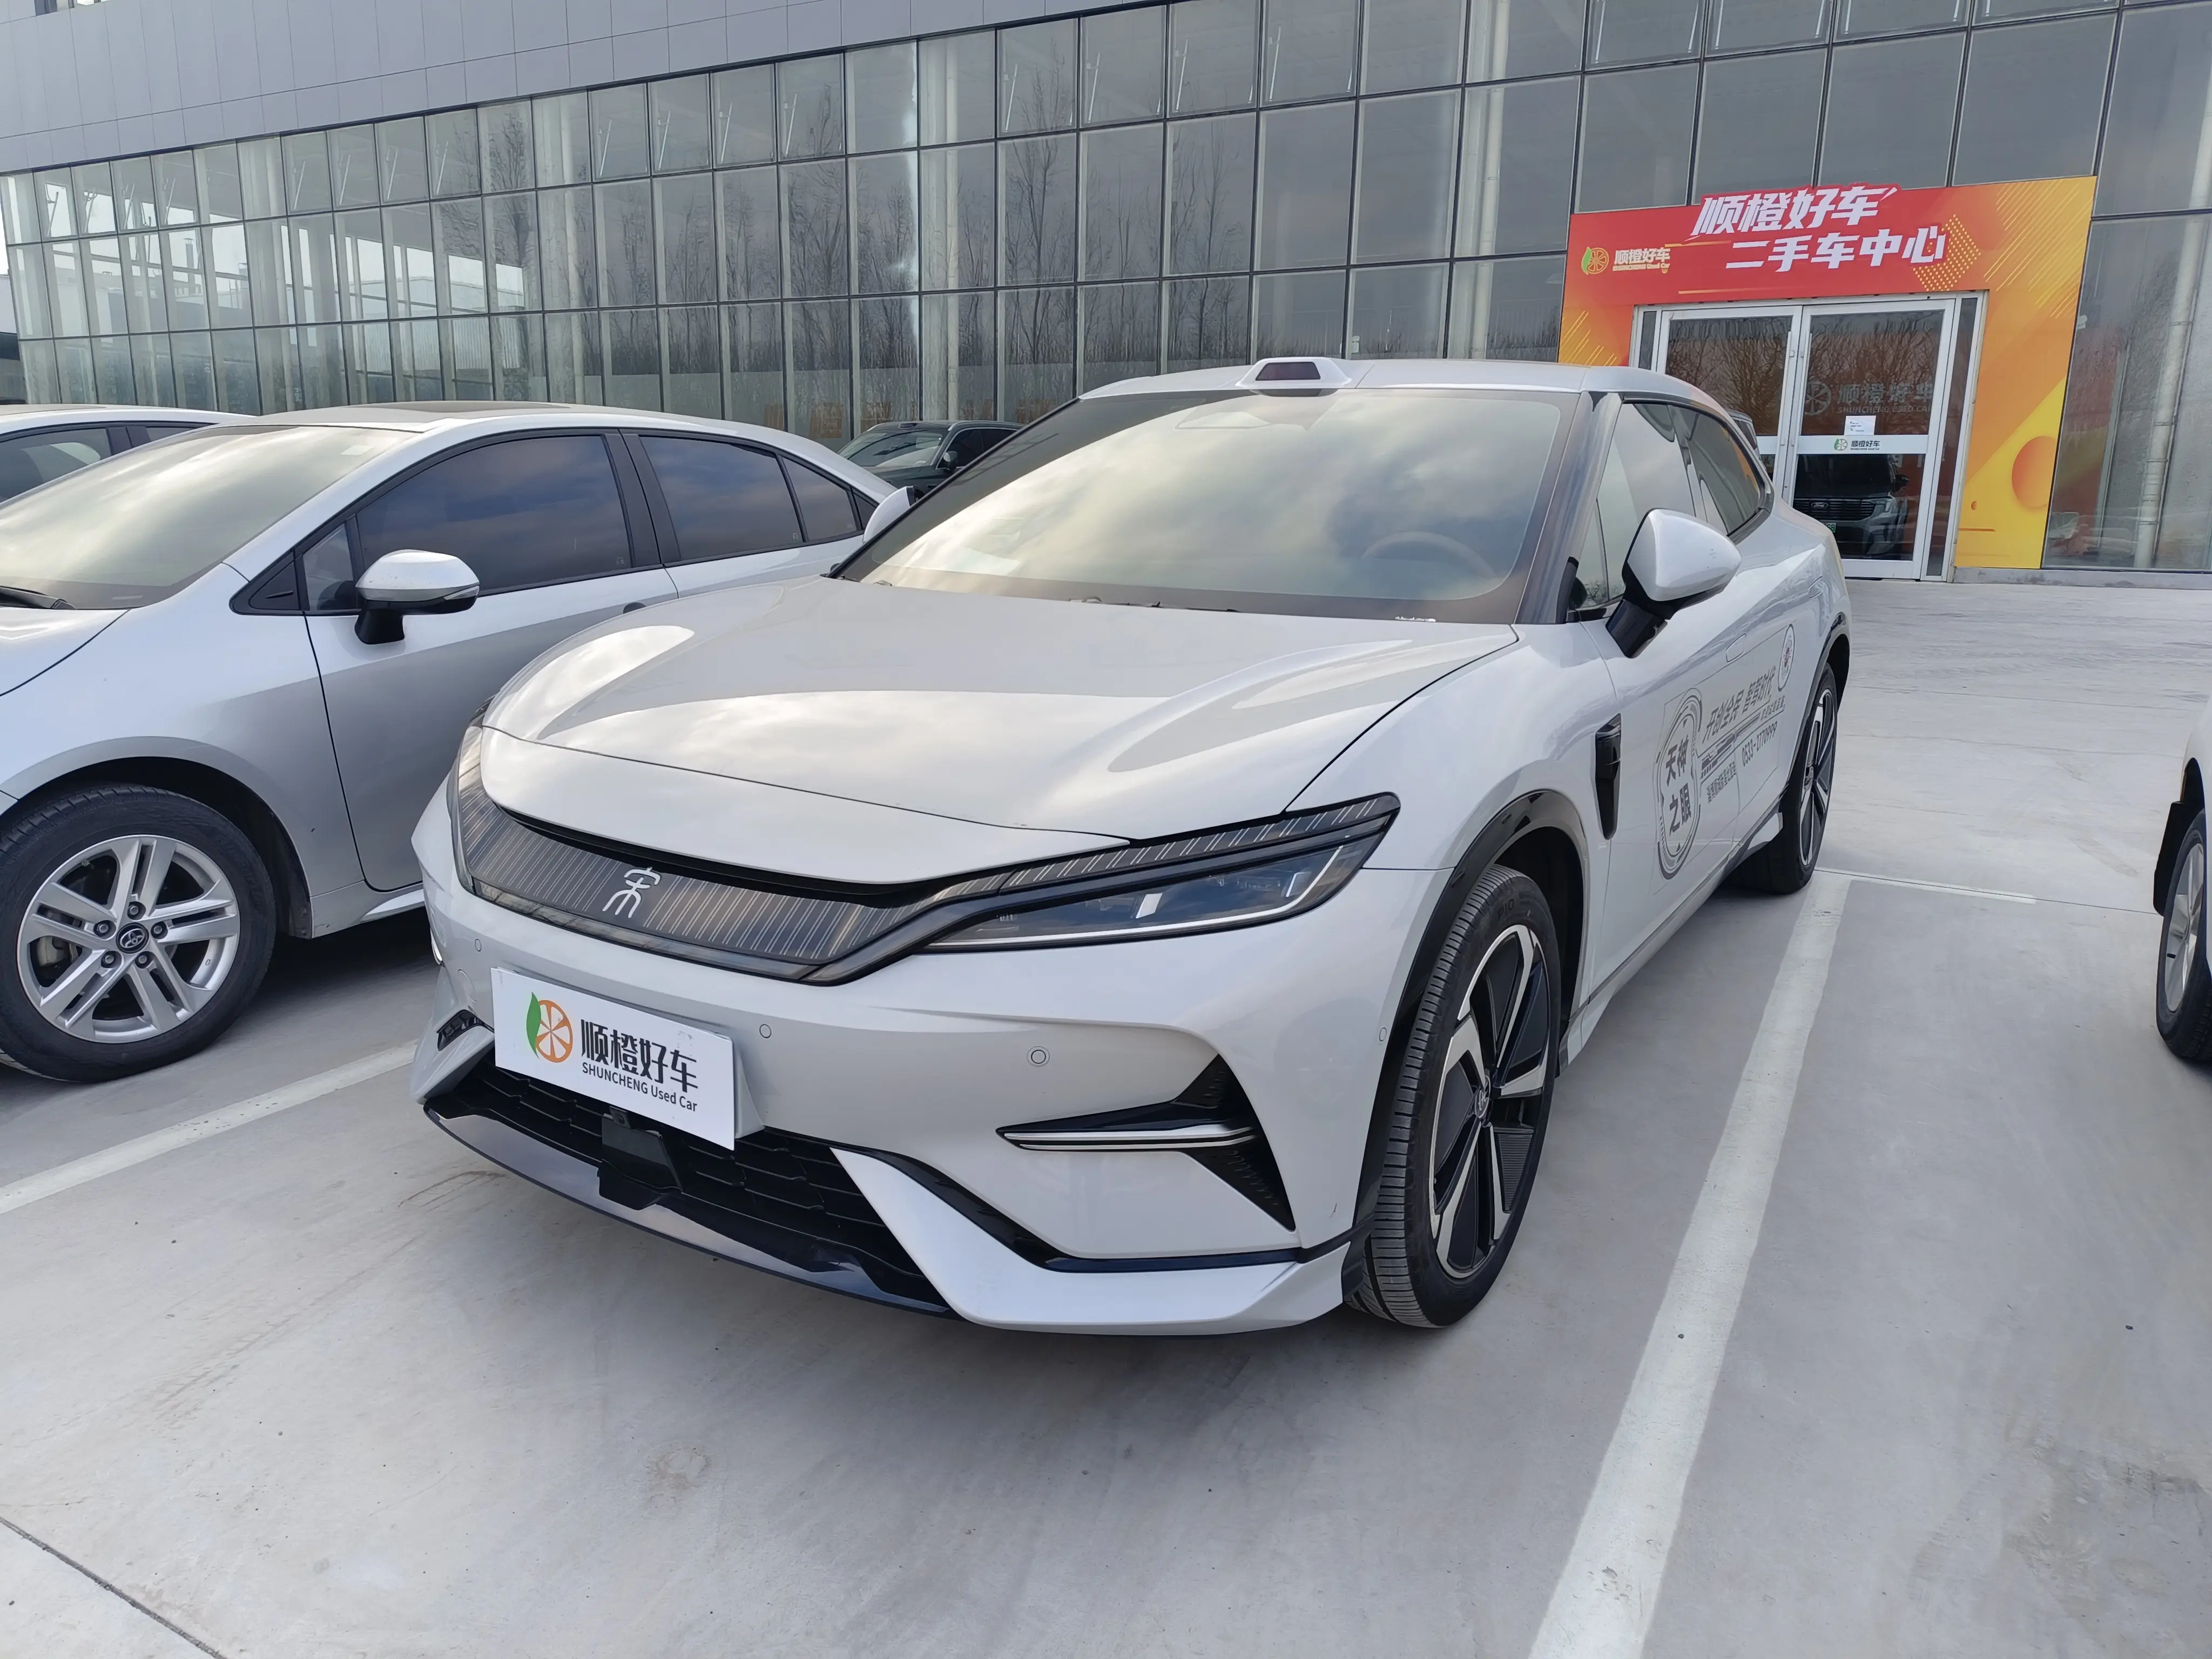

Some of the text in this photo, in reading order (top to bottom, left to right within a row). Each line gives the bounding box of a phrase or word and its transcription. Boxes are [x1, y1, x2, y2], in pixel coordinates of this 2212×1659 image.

[1690, 186, 1890, 236] 顺橙好车
[1614, 247, 1670, 265] 顺橙好车
[1725, 225, 1946, 272] 二手车中心
[1837, 406, 1889, 414] SHUNCHENG
[1666, 734, 1689, 787] 天神
[1669, 783, 1691, 837] 之眼
[581, 1019, 698, 1092] 顺橙好车
[582, 1062, 698, 1112] SHUNCHENG Used Car
